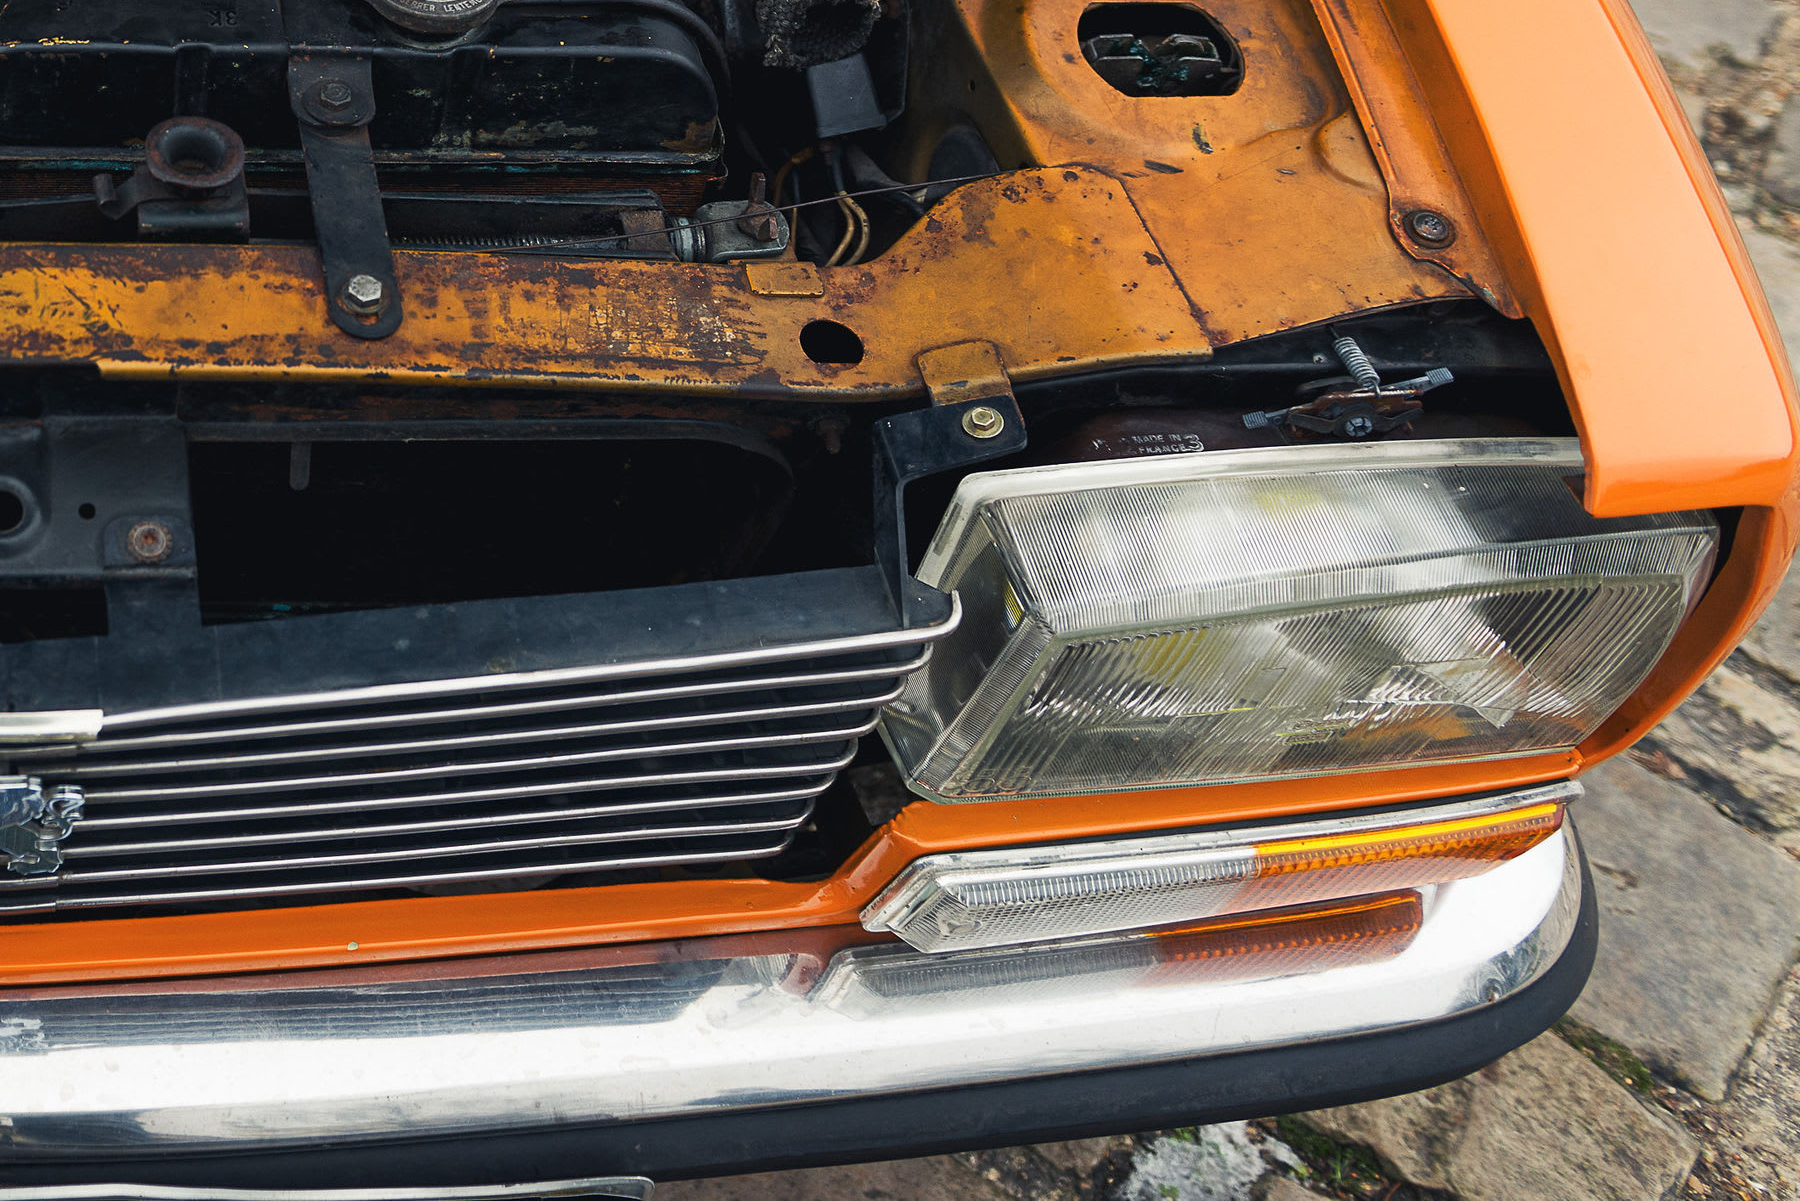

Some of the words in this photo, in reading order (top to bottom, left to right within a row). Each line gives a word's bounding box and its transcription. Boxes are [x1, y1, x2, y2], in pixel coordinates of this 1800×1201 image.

[209, 9, 239, 26] 3K
[1131, 434, 1164, 444] MADE
[1168, 433, 1182, 442] IN
[1138, 444, 1186, 454] FRANCE
